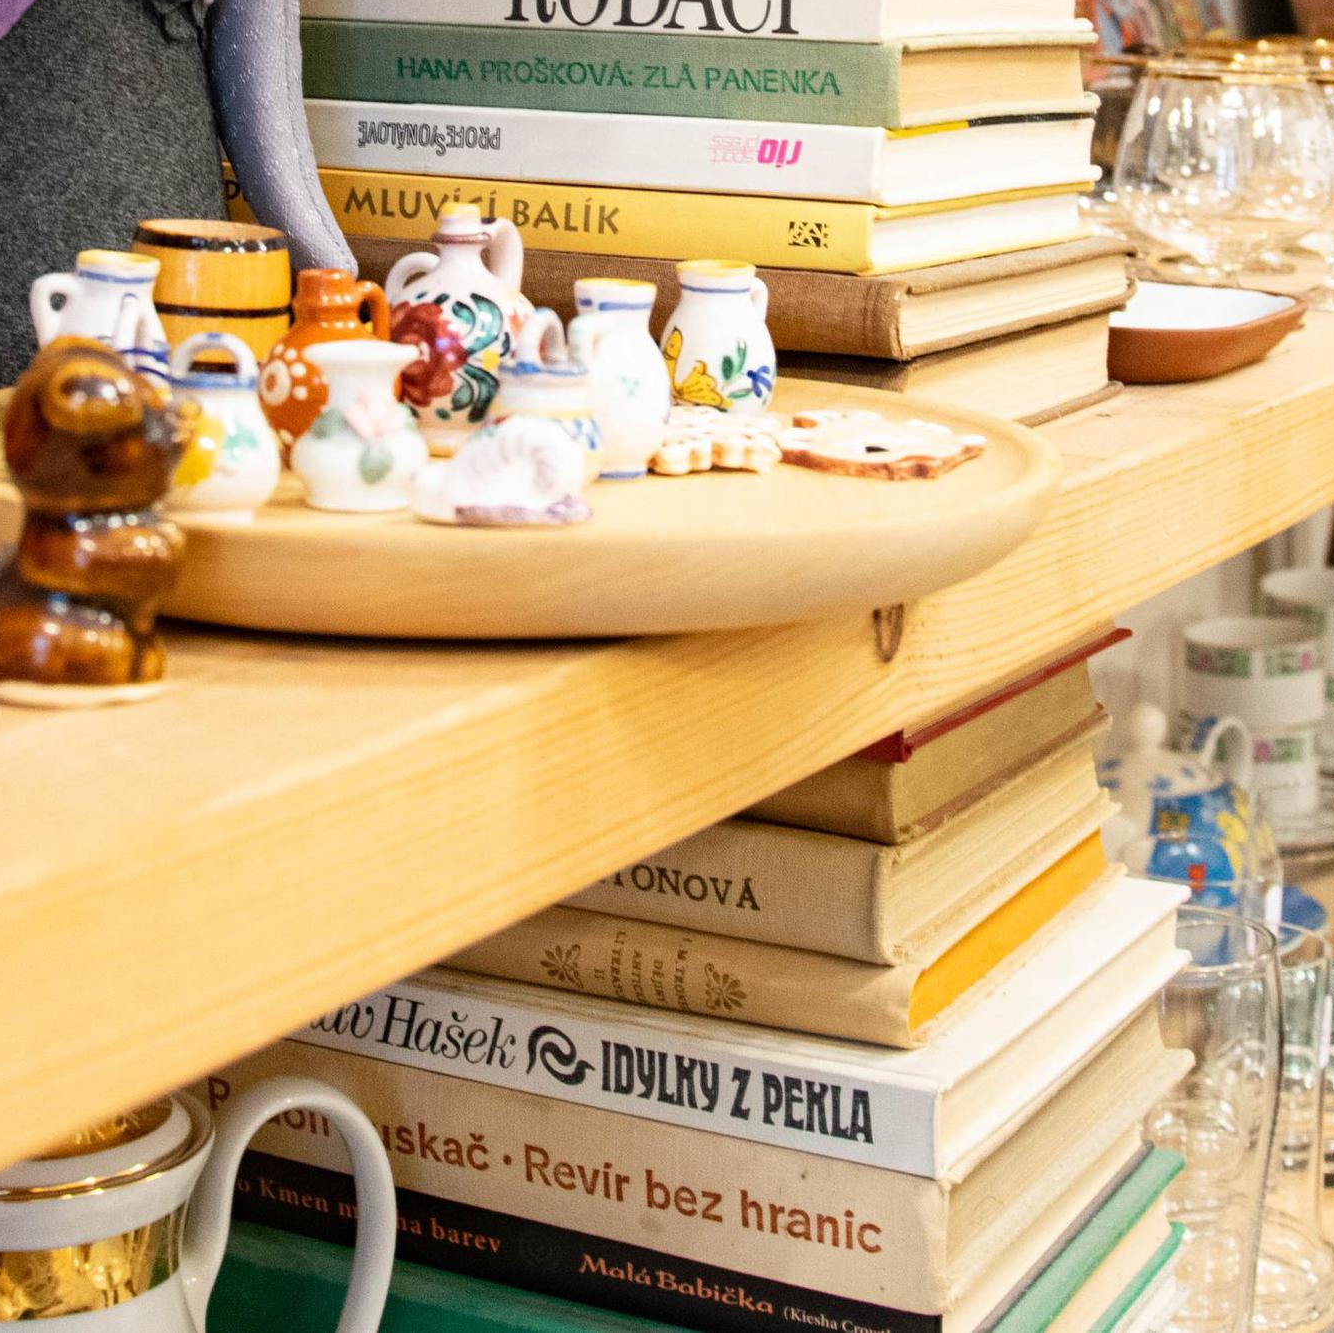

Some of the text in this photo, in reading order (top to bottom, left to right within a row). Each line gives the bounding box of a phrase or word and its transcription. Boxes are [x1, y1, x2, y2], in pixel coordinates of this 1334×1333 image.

[397, 55, 842, 97] HANA PROŠKOVÁ: ZLÁ PANENKA
[757, 138, 803, 168] rio
[343, 186, 620, 237] MLUVÍ BALÍK
[599, 864, 760, 911] ONOVÁ
[375, 994, 517, 1070] Hašek
[601, 1039, 720, 1112] IDYLKY
[730, 1067, 752, 1121] Z
[762, 1072, 874, 1144] PEKLA
[373, 1122, 883, 1255] skač Revír bez hranic
[259, 1176, 329, 1213] Kmen
[428, 1216, 501, 1255] barev
[578, 1252, 652, 1288] Malá
[655, 1269, 775, 1316] Babička
